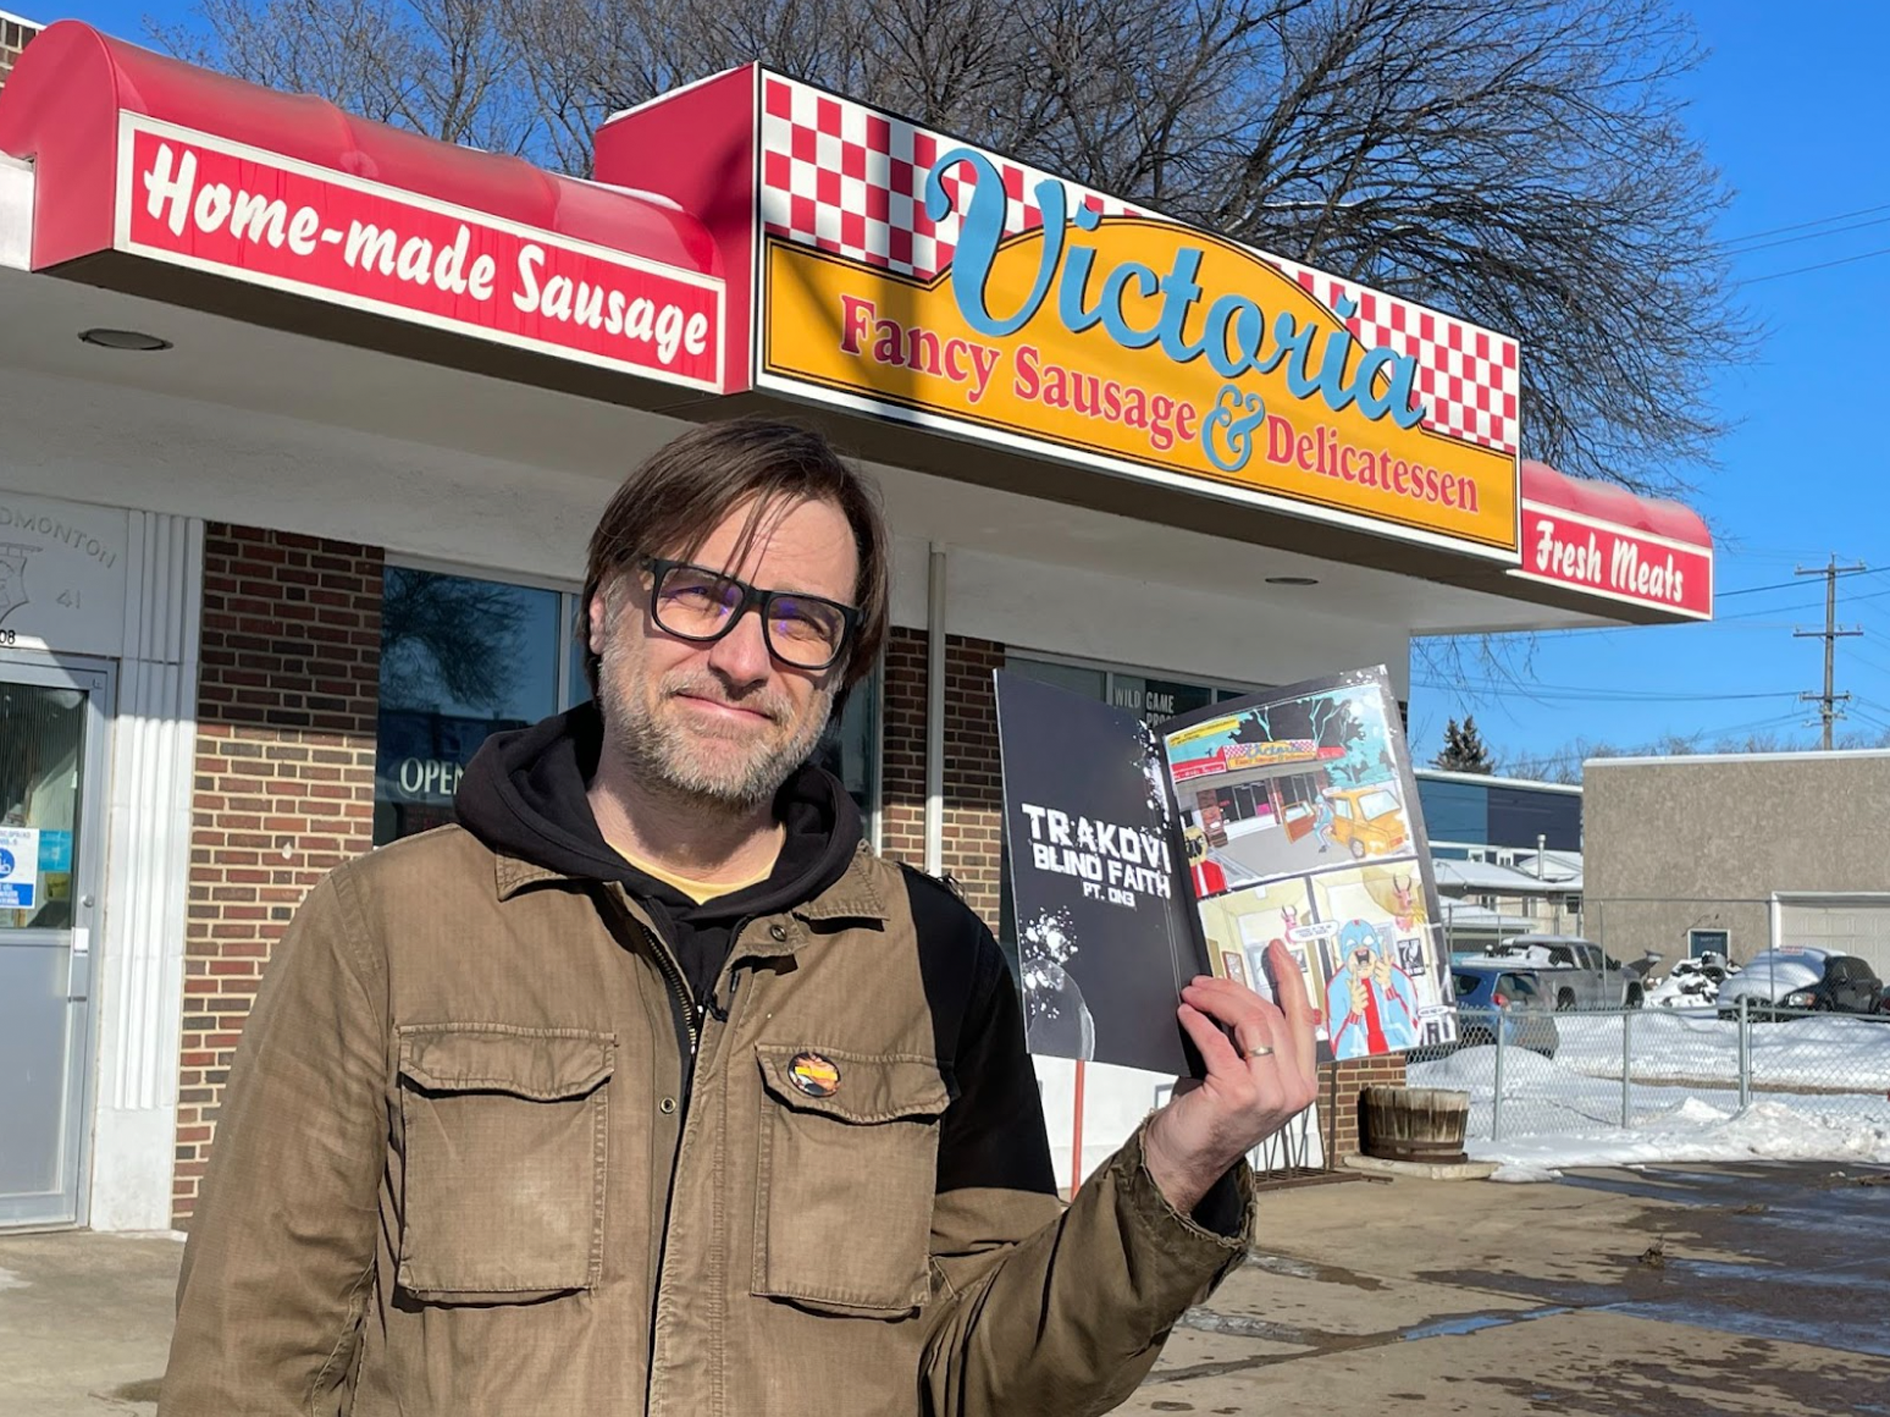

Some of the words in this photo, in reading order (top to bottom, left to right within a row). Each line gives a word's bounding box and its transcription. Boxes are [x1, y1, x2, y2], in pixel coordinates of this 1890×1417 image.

[144, 142, 494, 301] Home-made
[512, 245, 708, 365] Sausage
[925, 147, 1426, 430] Victoria
[839, 294, 1001, 404] Fancy
[1013, 344, 1197, 451] Sausage
[1201, 384, 1265, 472] &
[1266, 413, 1479, 513] Delicatessen
[1536, 520, 1601, 584] Fresh
[1611, 537, 1683, 602] Meats
[55, 588, 82, 610] 41
[1115, 687, 1140, 708] WILD
[1146, 691, 1175, 713] GAME
[1021, 803, 1172, 874] TRAKOVI
[1032, 843, 1103, 881] BLIND
[1107, 859, 1171, 900] FAITH
[1083, 881, 1105, 900] PT.
